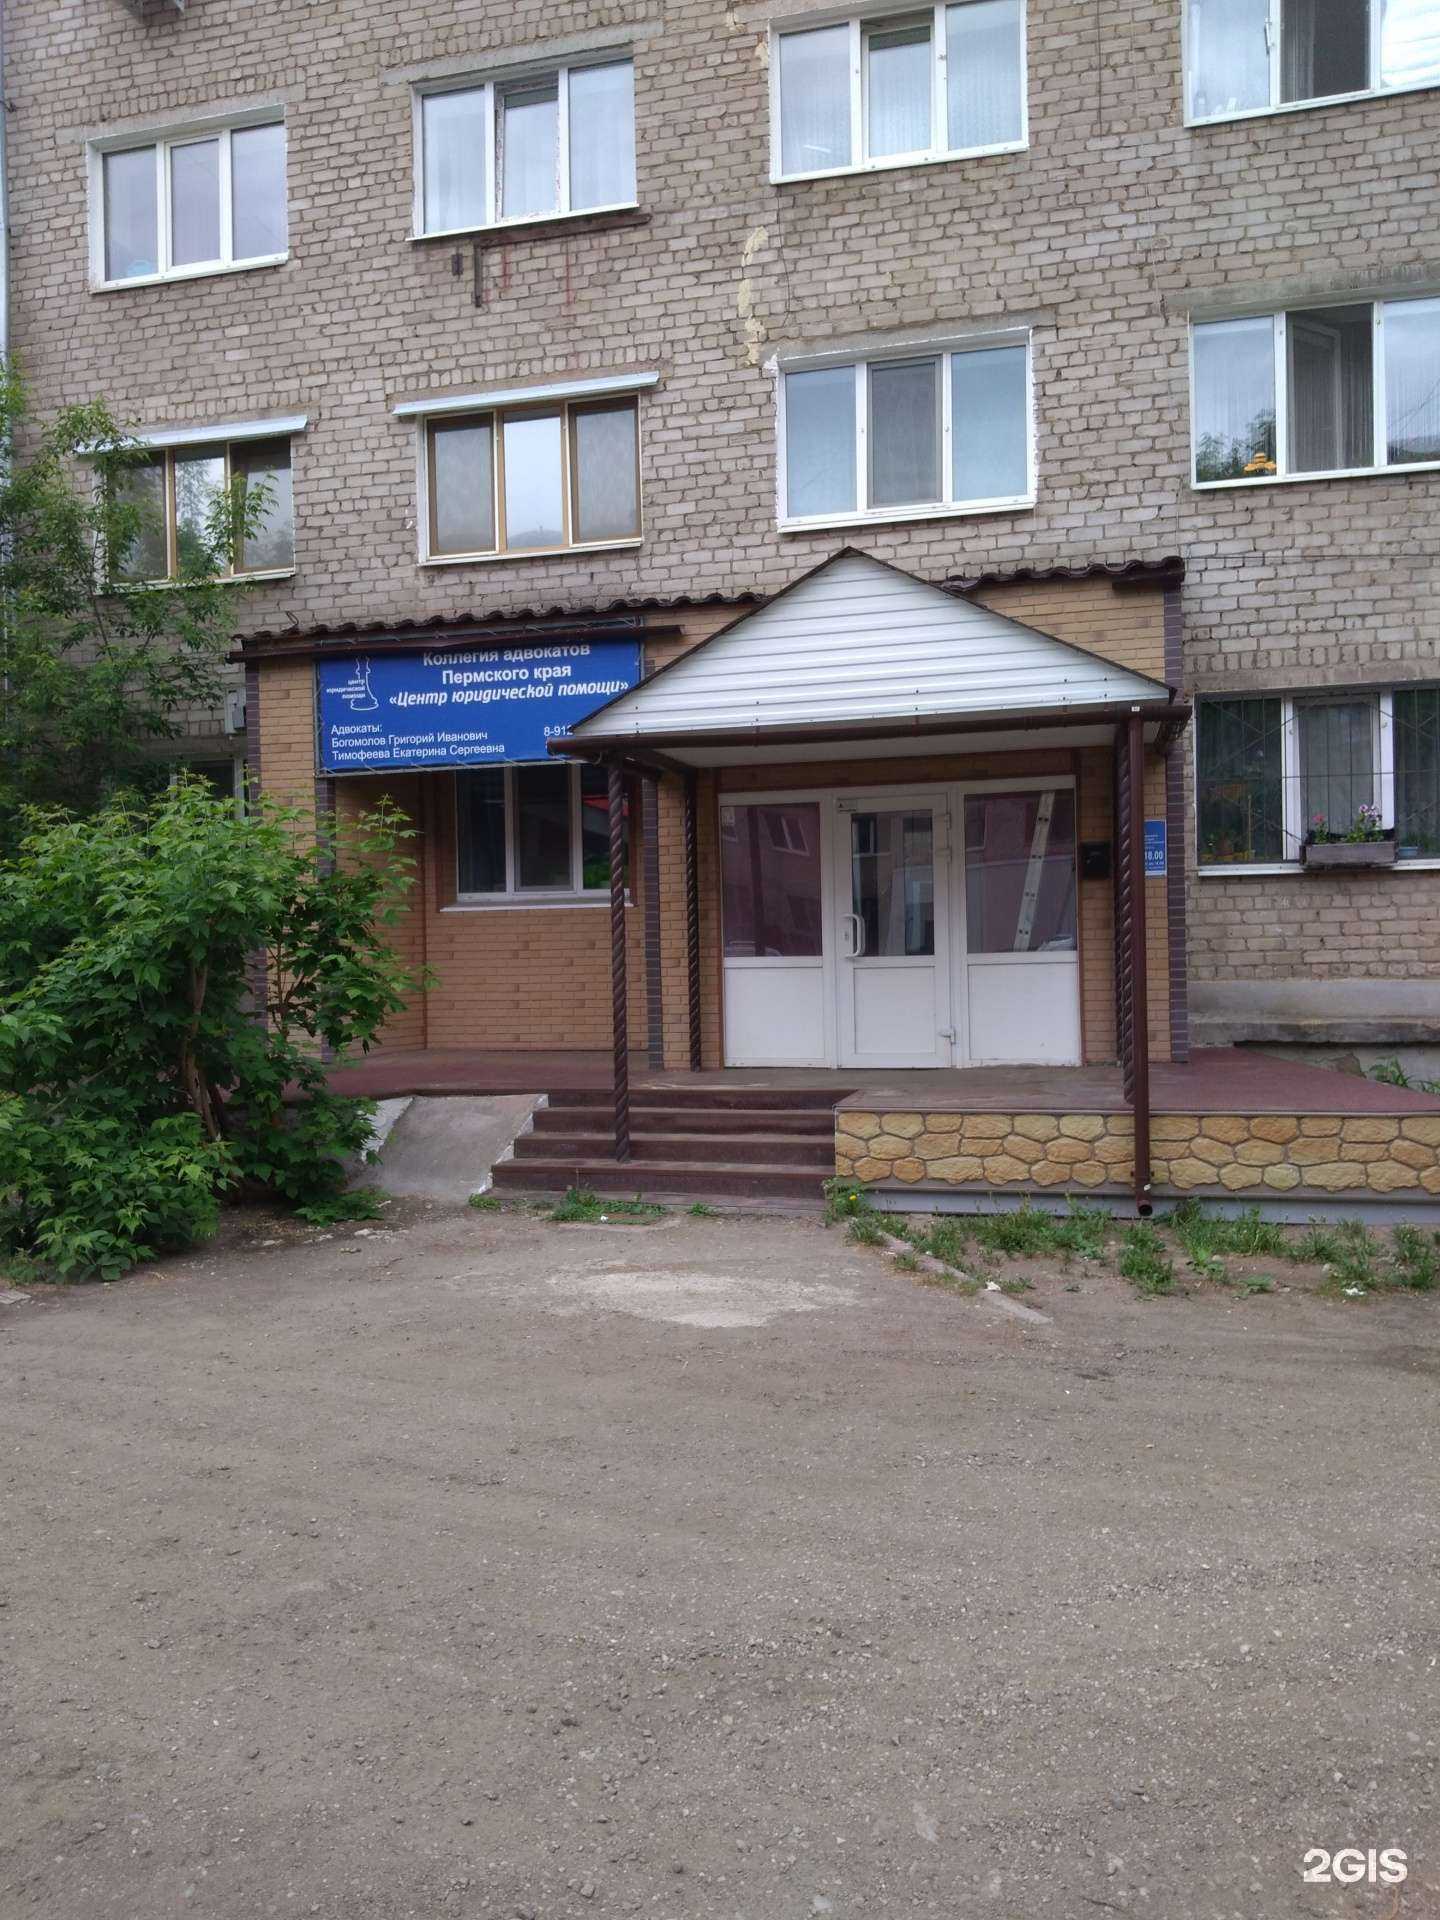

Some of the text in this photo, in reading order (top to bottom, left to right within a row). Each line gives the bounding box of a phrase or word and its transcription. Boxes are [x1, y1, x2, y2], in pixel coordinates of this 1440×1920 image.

[423, 644, 591, 666] Коллегия адвокатов
[442, 665, 572, 687] Пермского края
[389, 680, 629, 707] «Центр юридической помощи»
[331, 724, 383, 736] Адвокаты:
[332, 731, 488, 748] Богомолов Григорий Иванович
[332, 744, 505, 762] Тимофеева Екатерина Сергеевна
